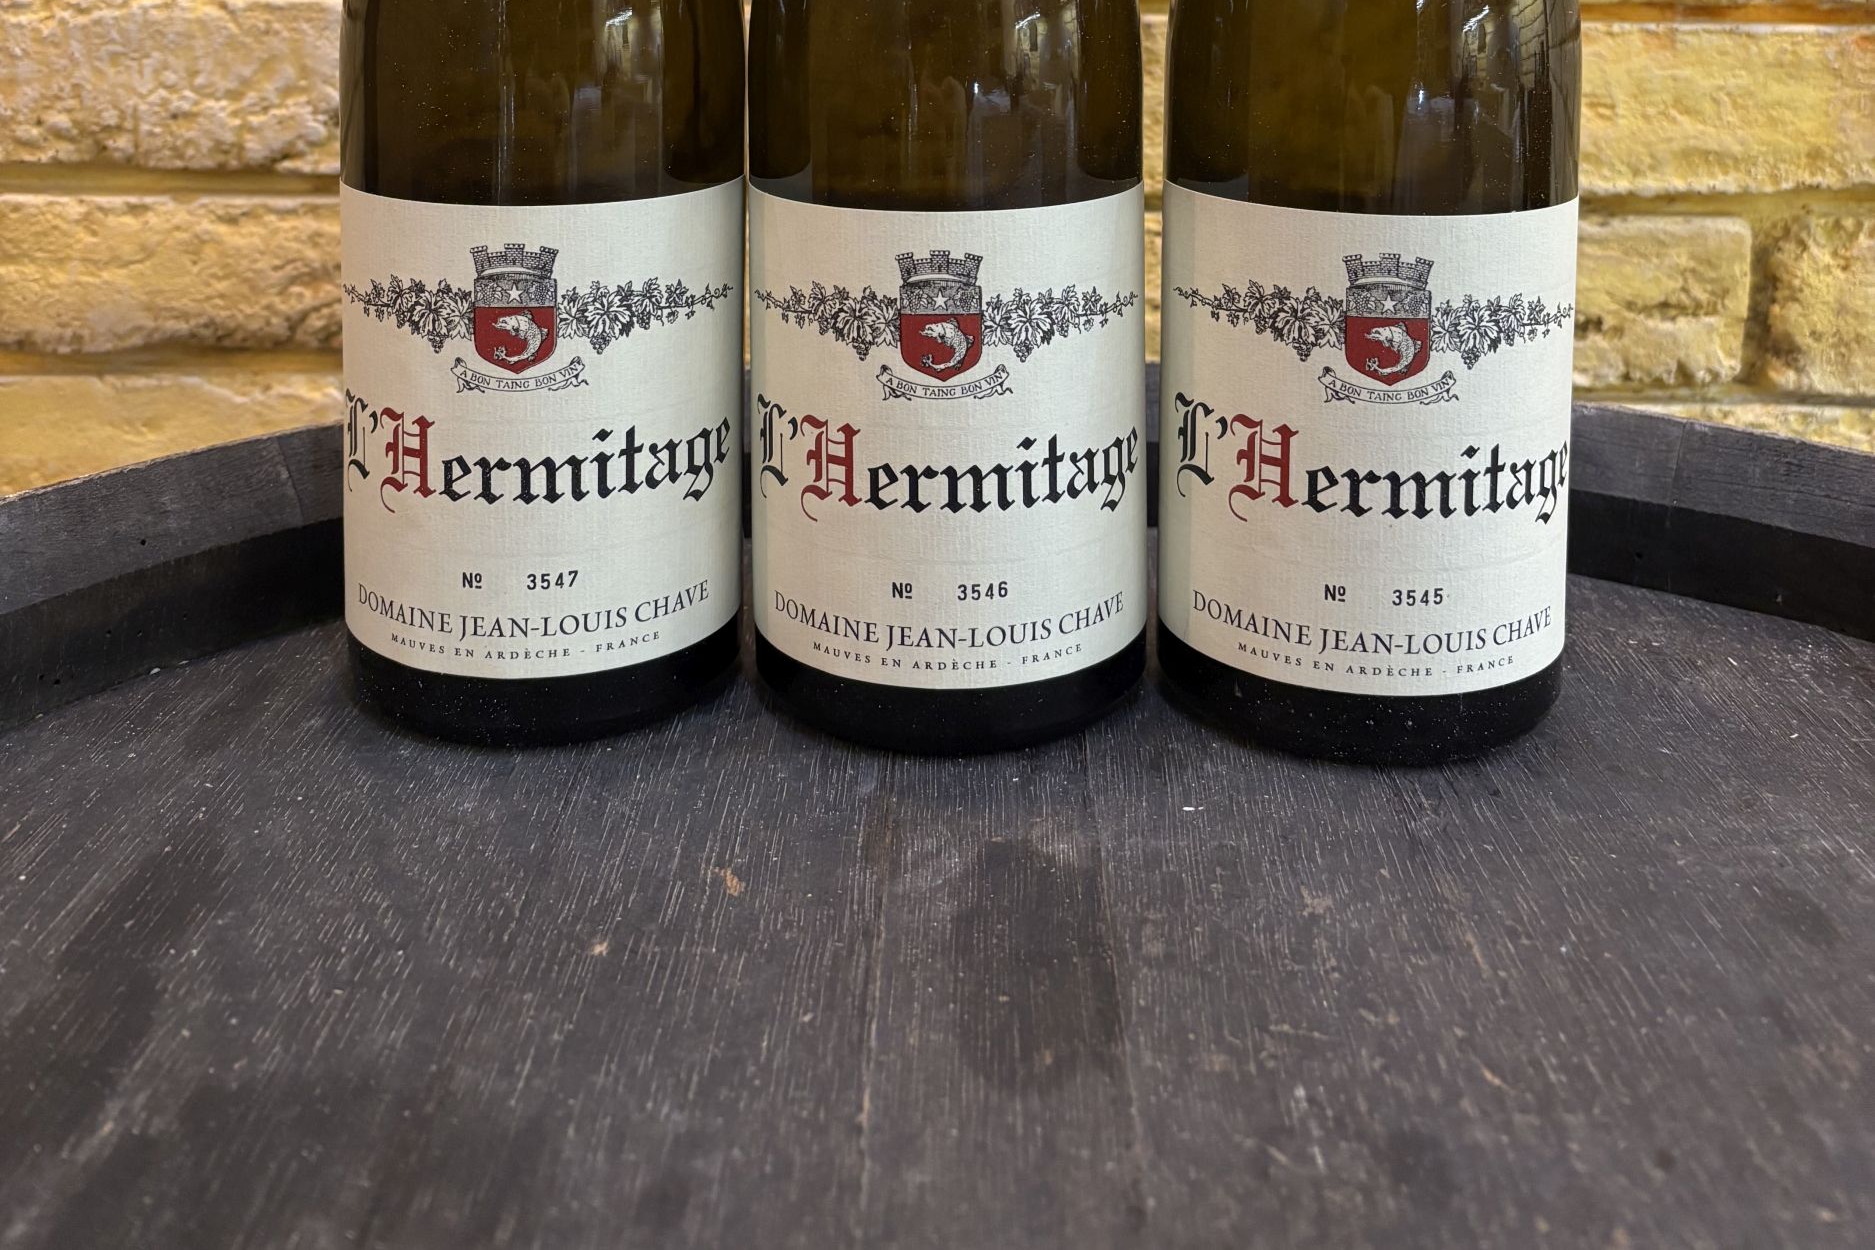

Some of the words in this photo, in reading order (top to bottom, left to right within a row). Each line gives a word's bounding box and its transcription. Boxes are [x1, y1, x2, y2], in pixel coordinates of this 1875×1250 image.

[460, 369, 467, 378] A
[470, 372, 491, 386] BON
[535, 374, 557, 387] BON
[559, 363, 579, 378] VIN
[886, 377, 893, 386] A
[896, 381, 917, 394] BON
[961, 383, 983, 395] BON
[984, 372, 1003, 386] VIN
[1328, 379, 1336, 387] A
[1339, 382, 1361, 397] BON
[1407, 388, 1429, 400] BON
[1431, 379, 1450, 392] VIN
[345, 387, 732, 514] L'Hermitage
[757, 393, 1139, 522] L'Hermitage
[1175, 391, 1568, 525] L'Hermitage
[526, 569, 580, 591] 3547
[957, 580, 1009, 601] 3546
[357, 582, 453, 634] DOMAINE
[459, 606, 628, 642] JEAN-LOUIS
[634, 579, 710, 623] CHAVE
[1392, 588, 1444, 607] 3545
[774, 590, 880, 644] DOMAINE
[886, 617, 1052, 651] JEAN-LOUIS
[1058, 591, 1125, 636] CHAVE
[1193, 590, 1313, 647] DOMAINE
[1318, 627, 1487, 656] JEAN-LOUIS
[1492, 606, 1552, 647] CHAVE
[391, 633, 446, 654] MAUVES
[454, 647, 475, 658] EN
[484, 647, 572, 660] ARDÈCHE
[596, 631, 661, 653] FRANCE
[813, 642, 872, 664] MAUVES
[881, 657, 902, 668] EN
[912, 658, 998, 671] ARDÈCHE
[1022, 643, 1083, 665] FRANCE
[1238, 642, 1303, 667] MAUVES
[1313, 660, 1336, 672] EN
[1346, 664, 1434, 677] ARDÈCHE
[1456, 655, 1515, 675] FRANCE
